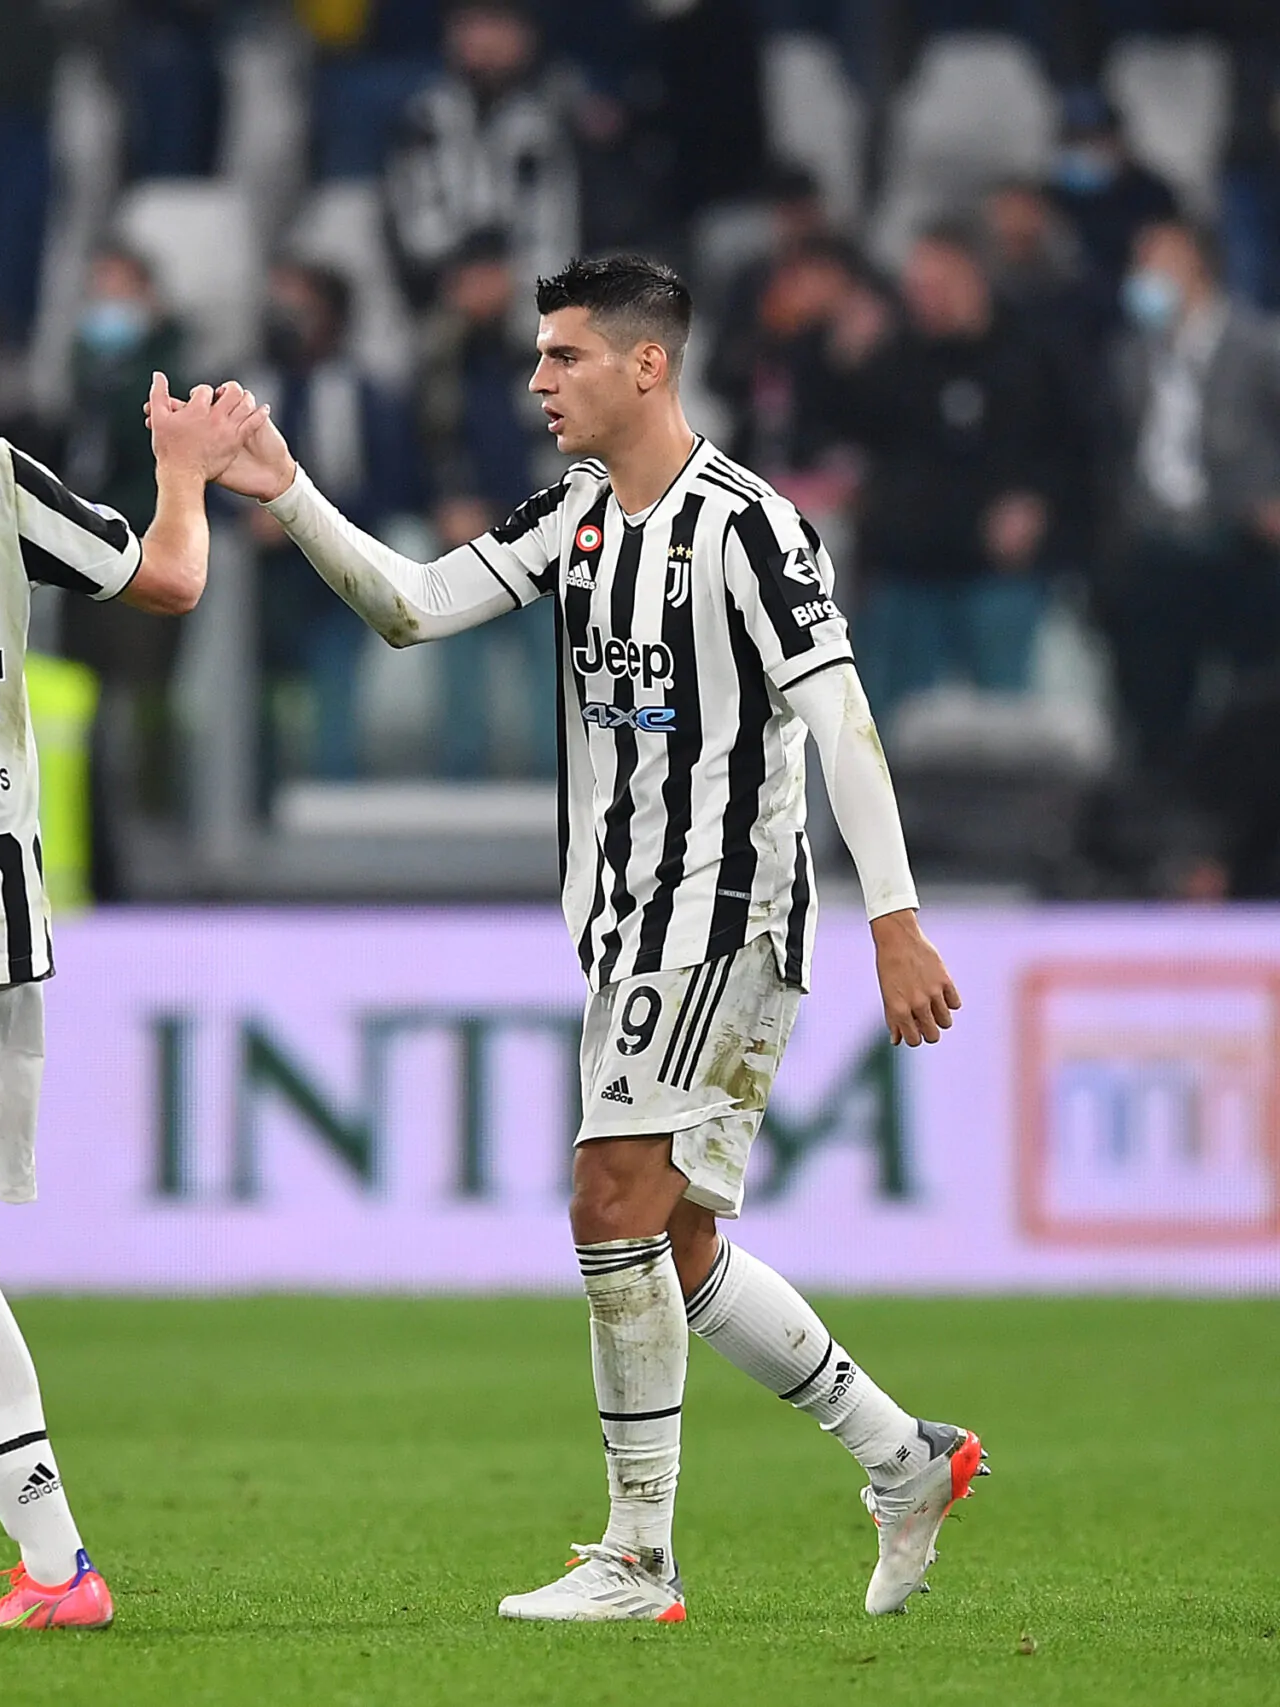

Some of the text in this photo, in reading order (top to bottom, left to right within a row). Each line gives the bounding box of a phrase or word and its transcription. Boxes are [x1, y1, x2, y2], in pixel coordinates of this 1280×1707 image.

[566, 575, 597, 591] adidas
[573, 624, 675, 691] Jeep
[616, 985, 663, 1056] 9
[600, 1090, 634, 1106] adidas
[17, 1479, 63, 1505] adida
